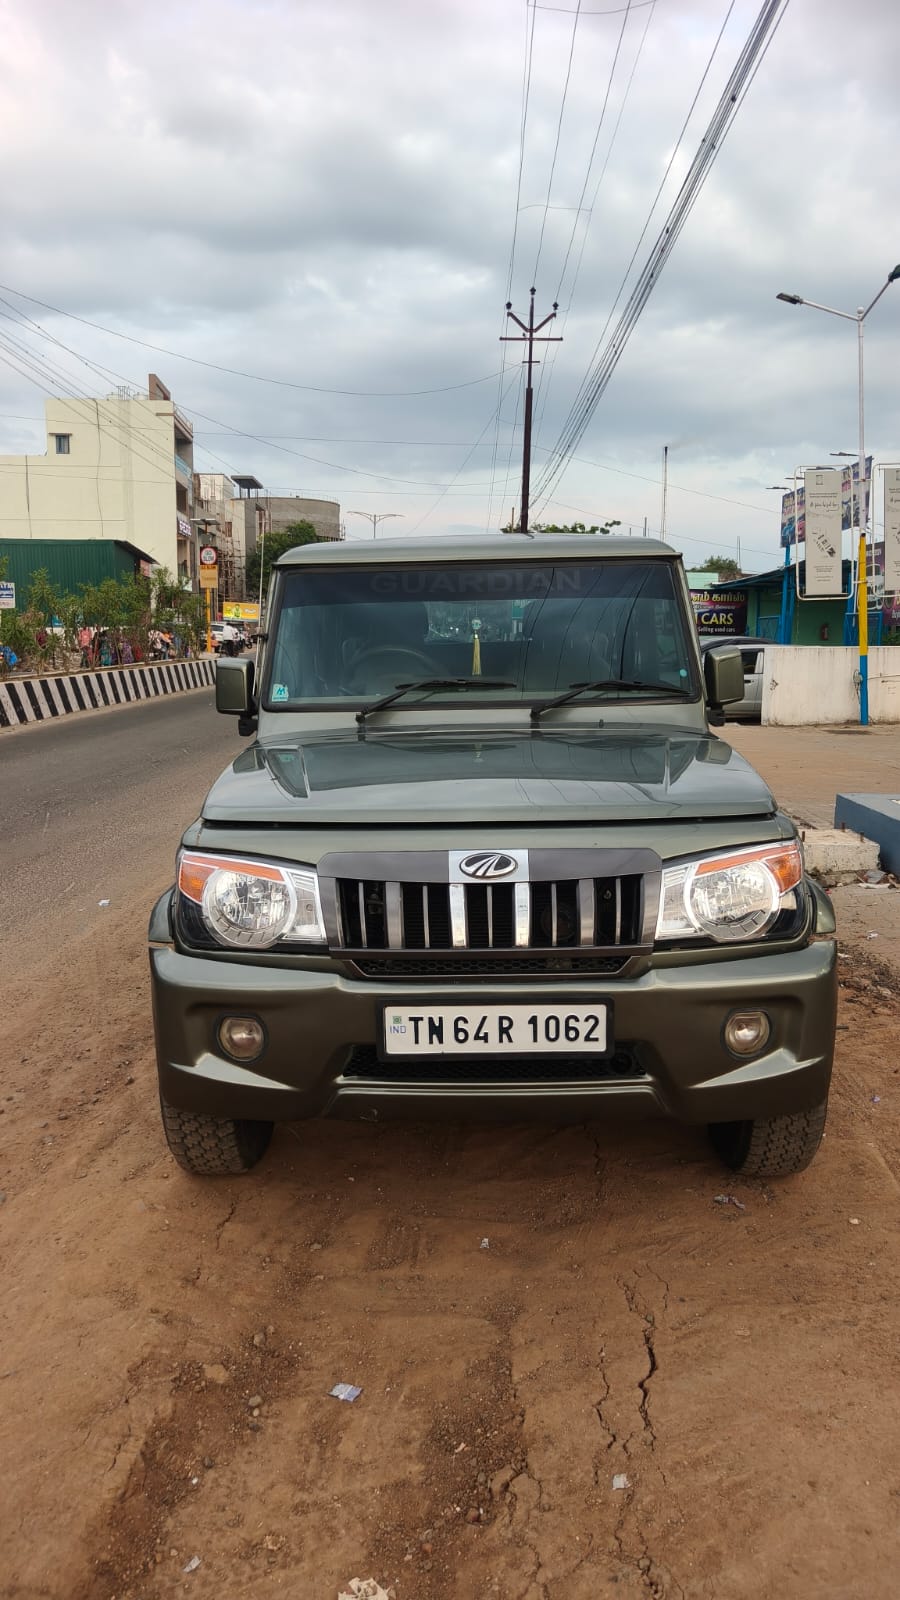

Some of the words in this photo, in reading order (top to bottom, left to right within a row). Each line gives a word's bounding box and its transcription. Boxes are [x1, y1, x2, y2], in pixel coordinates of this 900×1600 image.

[370, 569, 581, 593] GUARDIAN
[701, 613, 734, 625] CARS
[389, 1025, 407, 1034] IND
[408, 1016, 444, 1045] TN
[453, 1015, 489, 1044] 64
[498, 1015, 514, 1043] R
[527, 1014, 600, 1043] 1062
